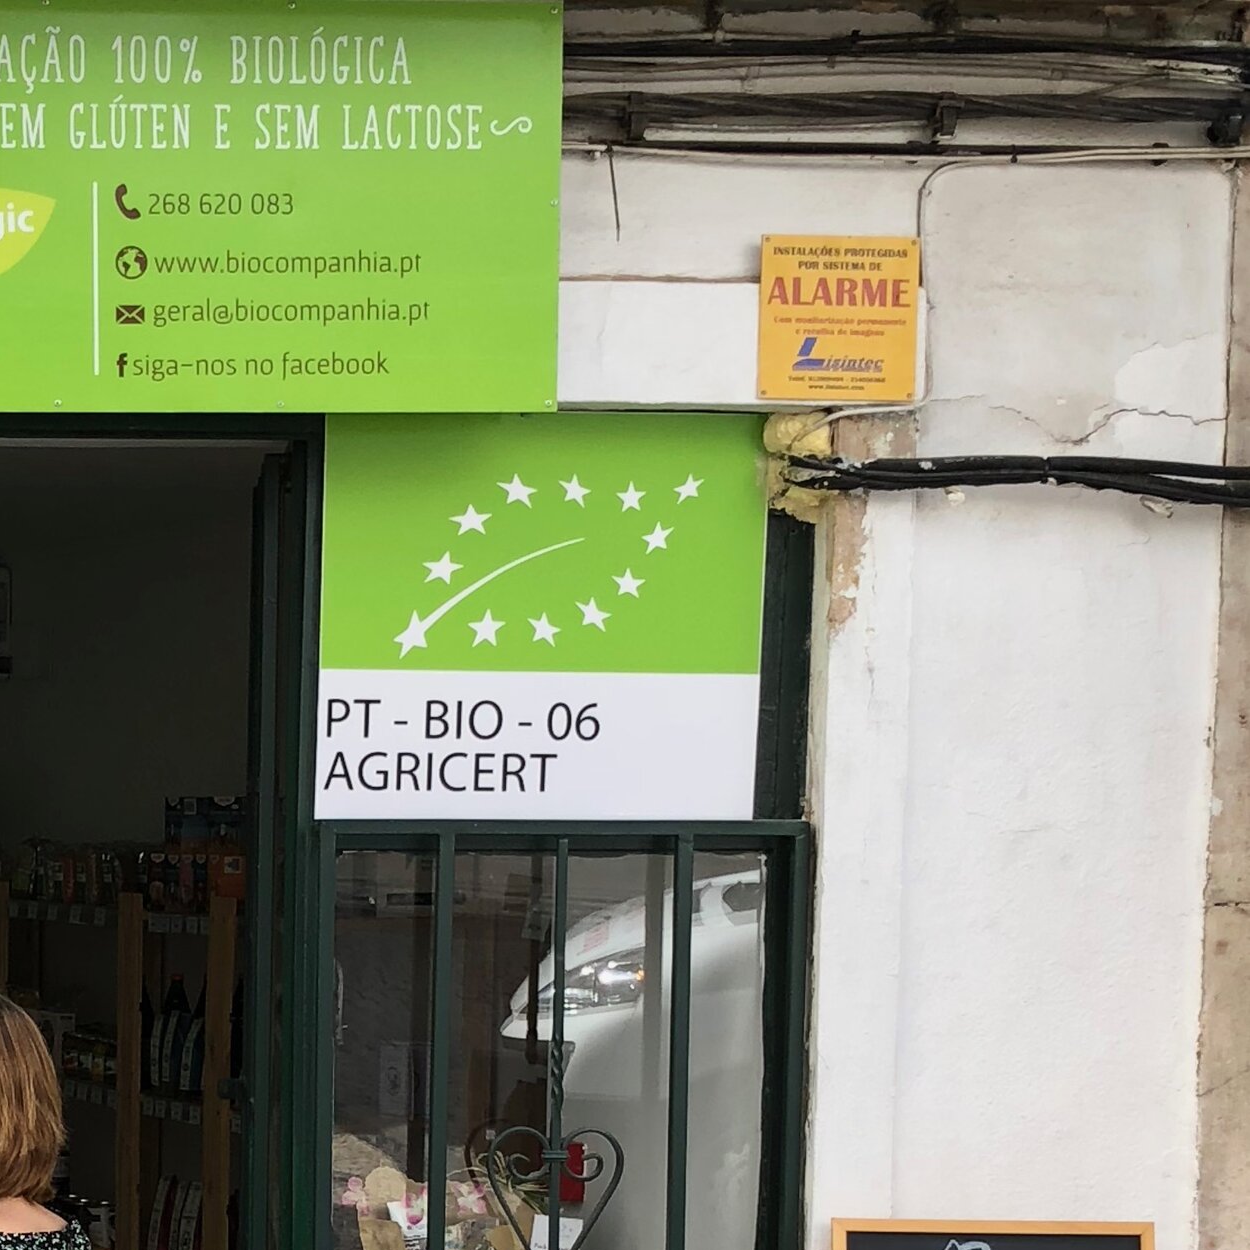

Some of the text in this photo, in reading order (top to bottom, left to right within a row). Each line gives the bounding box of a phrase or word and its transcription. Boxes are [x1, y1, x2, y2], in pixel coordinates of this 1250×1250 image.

[111, 35, 203, 85] 100%
[231, 26, 412, 85] BIOLÓGICA
[70, 94, 191, 150] GLÚTEN
[215, 104, 231, 149] E
[254, 104, 320, 150] SEM
[341, 104, 483, 150] LACTOSE
[148, 193, 295, 216] 268 620 083
[154, 249, 422, 279] www.biocompanhia.pt
[773, 246, 908, 259] INSTALAÇÕES PROTEGIDAS
[798, 261, 883, 272] POR SISTEMA DE
[767, 276, 911, 308] ALARME
[153, 298, 430, 328] geral@biocompanhia.pt
[132, 351, 390, 381] siga-nos no facebook
[792, 337, 884, 373] Lisintec
[325, 698, 381, 739] PT
[424, 700, 504, 741] BIO
[547, 702, 601, 742] 06
[323, 750, 558, 793] AGRICERT
